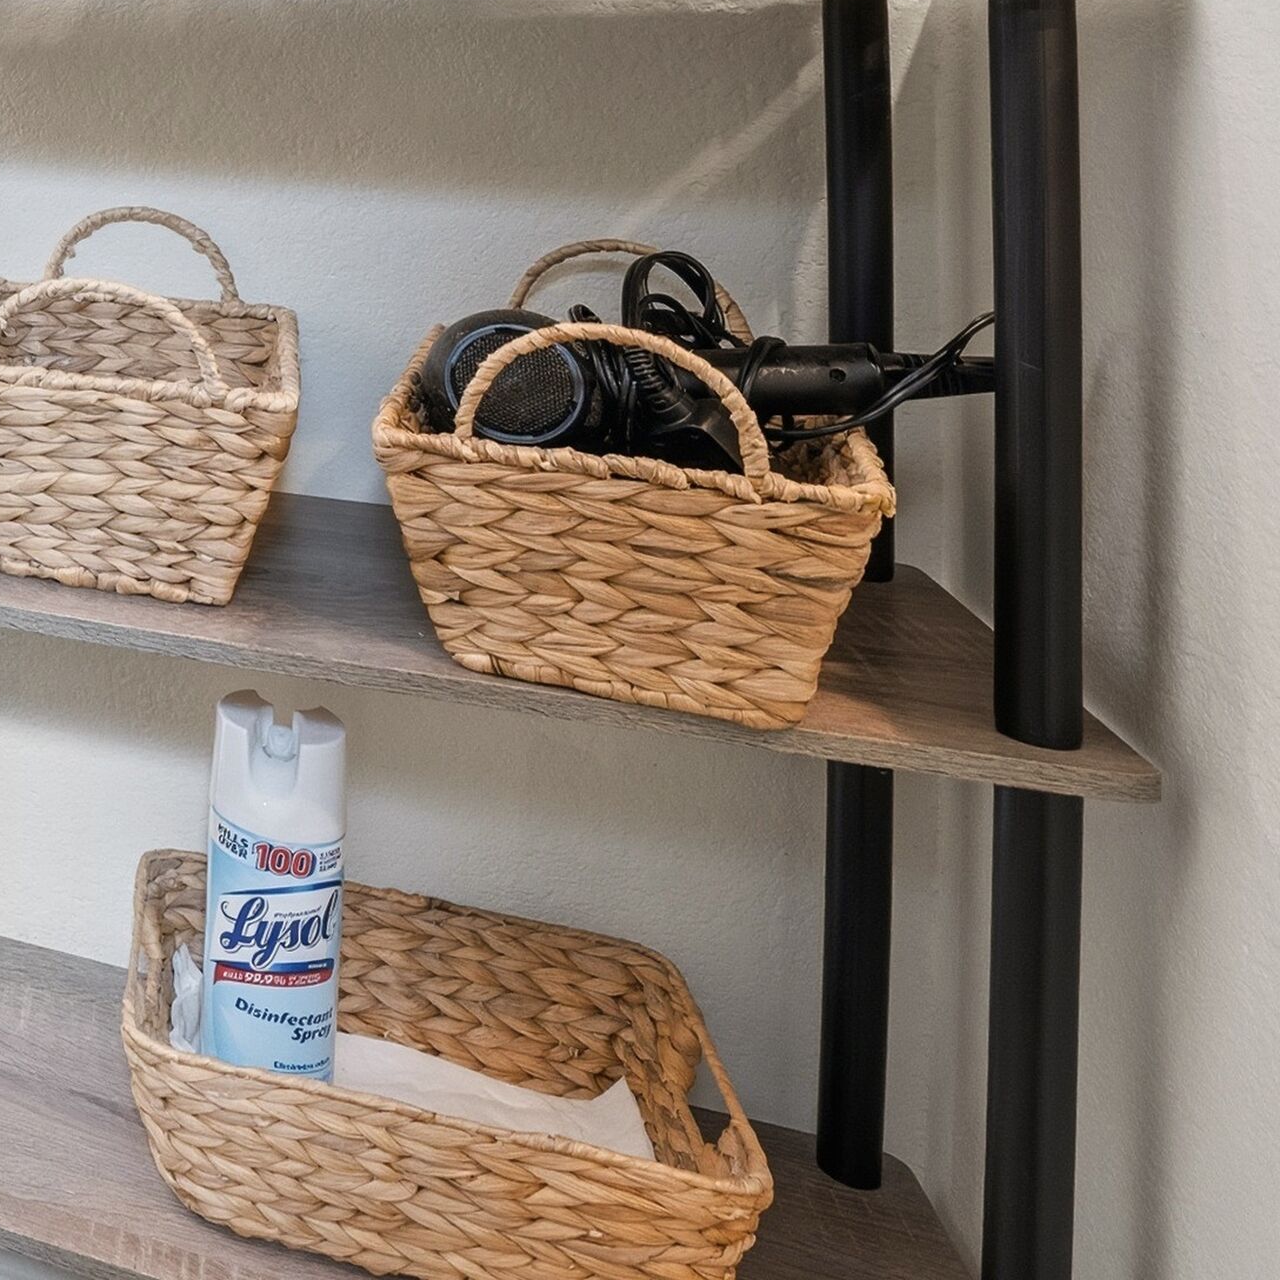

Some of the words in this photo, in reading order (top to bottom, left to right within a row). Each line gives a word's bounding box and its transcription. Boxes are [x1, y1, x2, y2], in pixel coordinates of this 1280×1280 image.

[218, 823, 249, 848] KILLS
[218, 834, 248, 860] OVER
[253, 841, 316, 879] 100
[220, 888, 338, 968] Lysol
[234, 997, 333, 1027] Disinfectant
[291, 1024, 332, 1044] Spray
